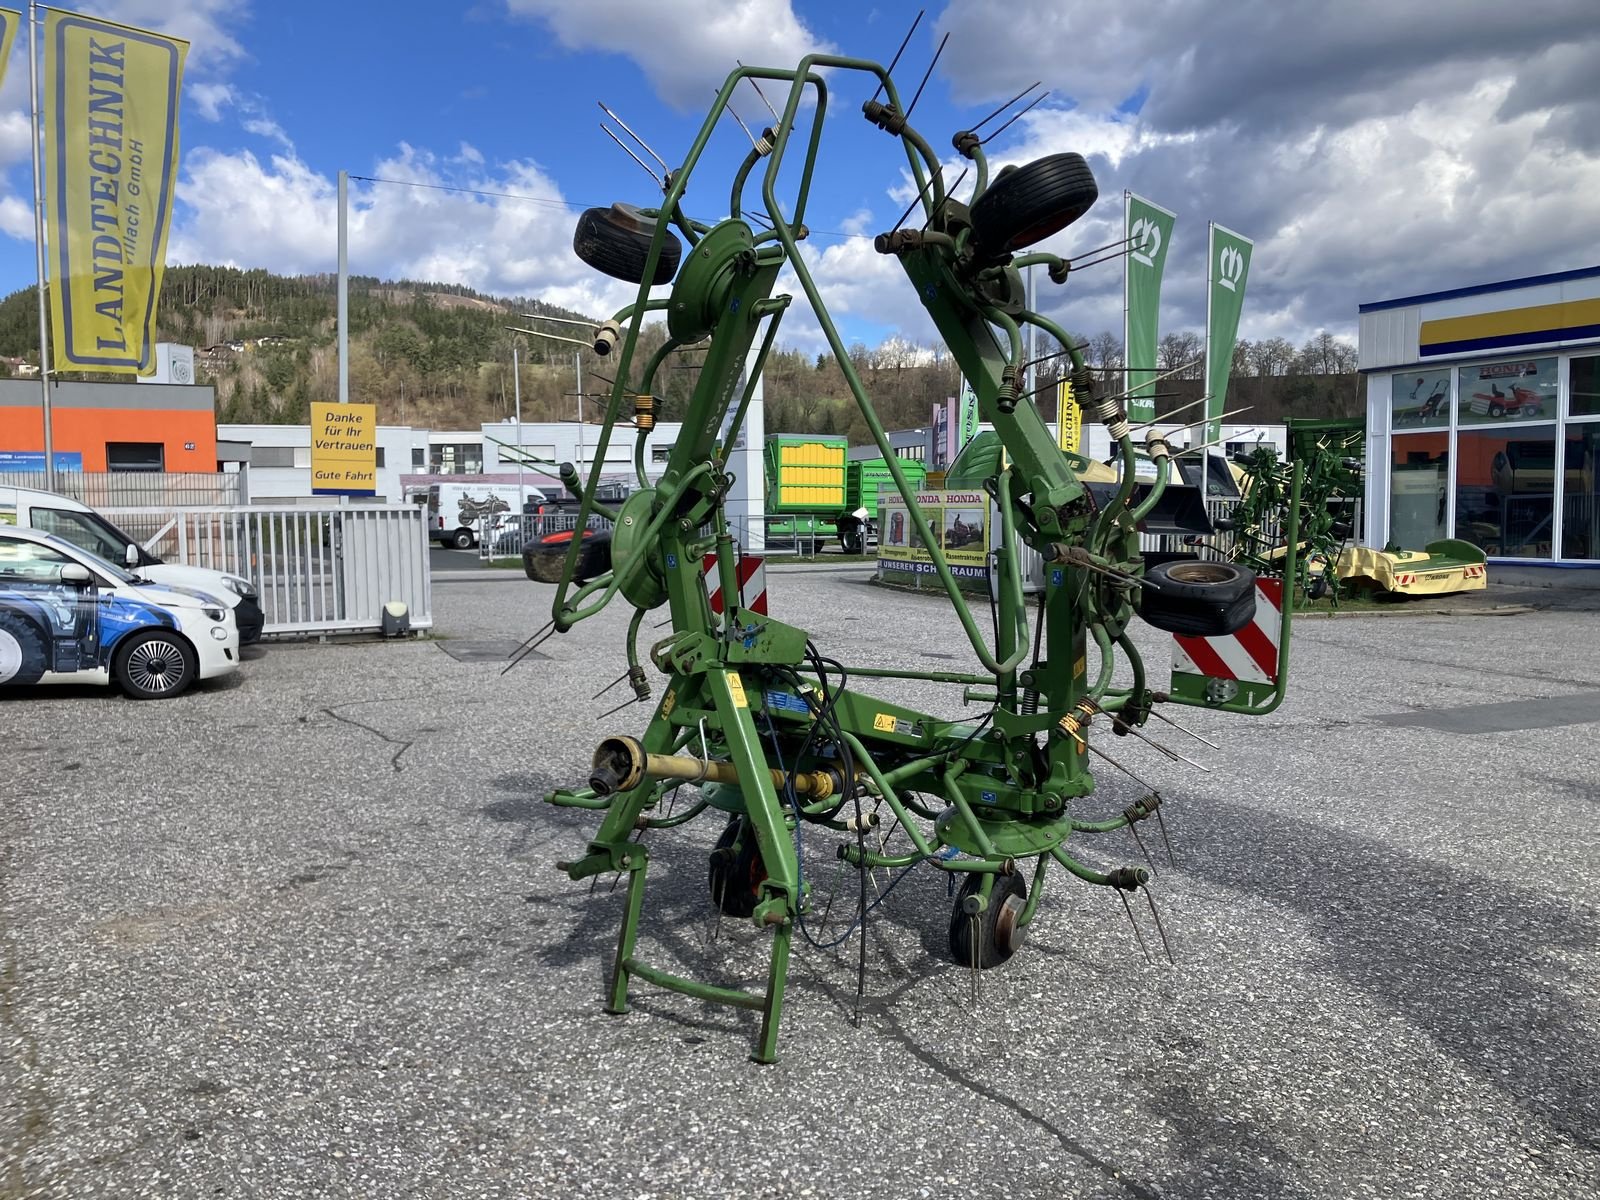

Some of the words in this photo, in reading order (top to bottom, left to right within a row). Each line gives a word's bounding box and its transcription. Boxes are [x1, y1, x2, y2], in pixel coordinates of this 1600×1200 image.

[128, 139, 144, 195] GmbH
[88, 37, 127, 353] LANDTECHNIK
[1480, 362, 1537, 375] HONDA
[325, 412, 363, 423] Danke
[325, 426, 342, 436] für
[346, 427, 362, 437] Ihr
[315, 440, 373, 451] Vertrauen
[315, 470, 341, 480] Gute
[345, 471, 373, 480] Fahrt
[915, 495, 940, 504] ONDA
[946, 494, 982, 503] HONDA
[945, 552, 983, 561] Rasentraktoren
[883, 560, 914, 571] UNSEREN
